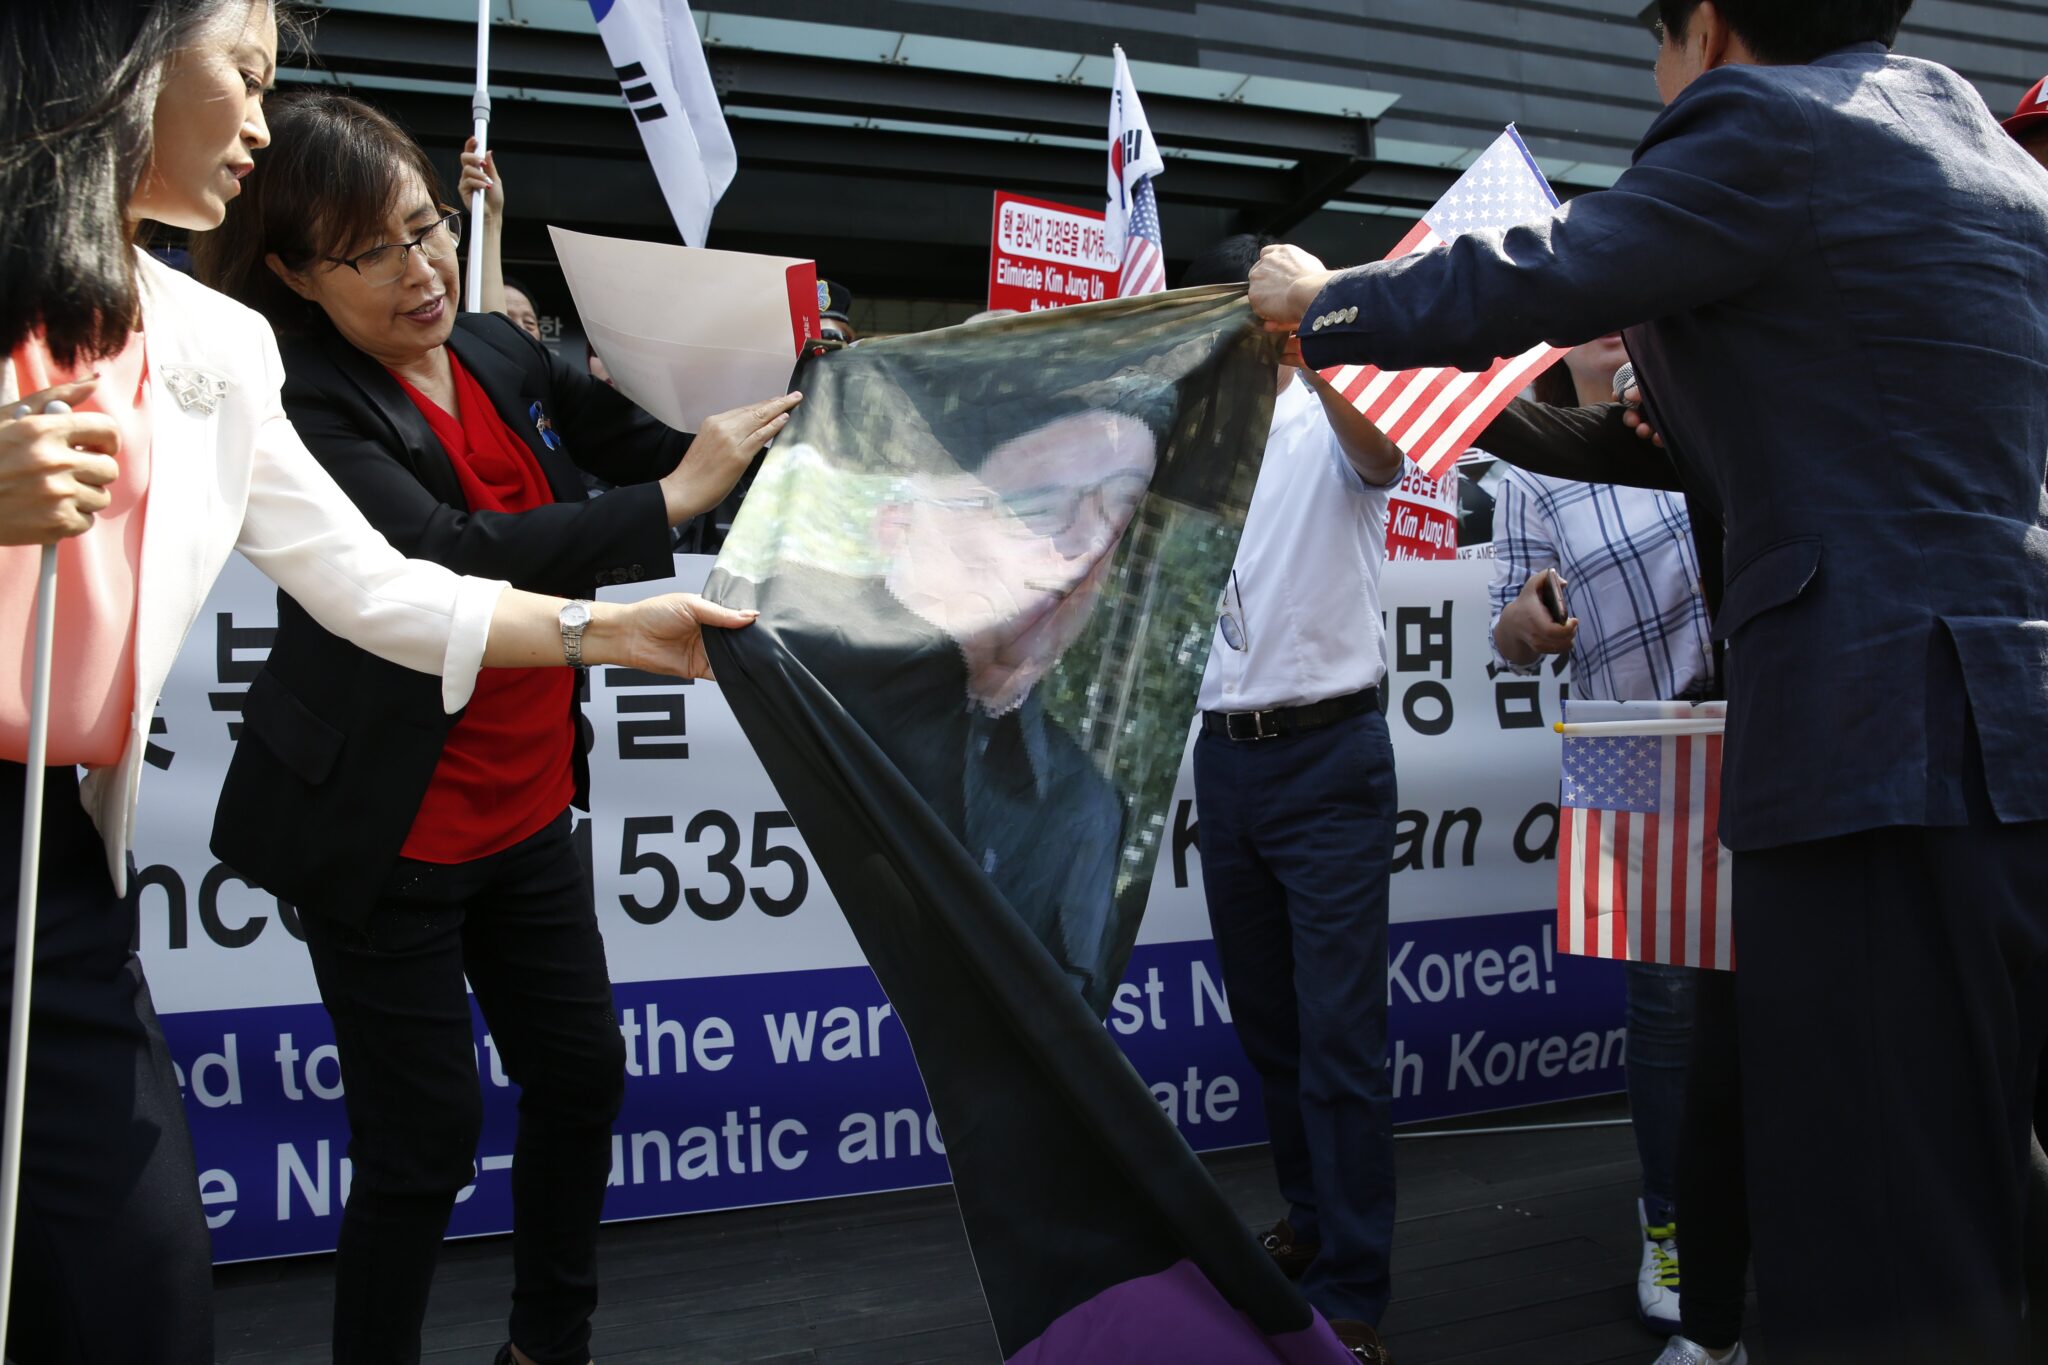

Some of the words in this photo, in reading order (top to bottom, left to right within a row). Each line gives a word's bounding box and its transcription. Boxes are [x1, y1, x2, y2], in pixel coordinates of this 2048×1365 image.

[1045, 217, 1079, 257] 김정은을
[997, 258, 1042, 290] Eliminate
[1045, 266, 1064, 293] Kim
[1065, 270, 1088, 301] Jung
[1090, 275, 1104, 300] Un
[1392, 506, 1418, 539] Kim
[1419, 512, 1444, 549] Jung
[618, 809, 809, 925] 535
[274, 1033, 345, 1101] to
[619, 1003, 735, 1077] the
[764, 1002, 891, 1064] war
[1387, 924, 1557, 1006] Korea!
[1447, 1027, 1627, 1091] Korean
